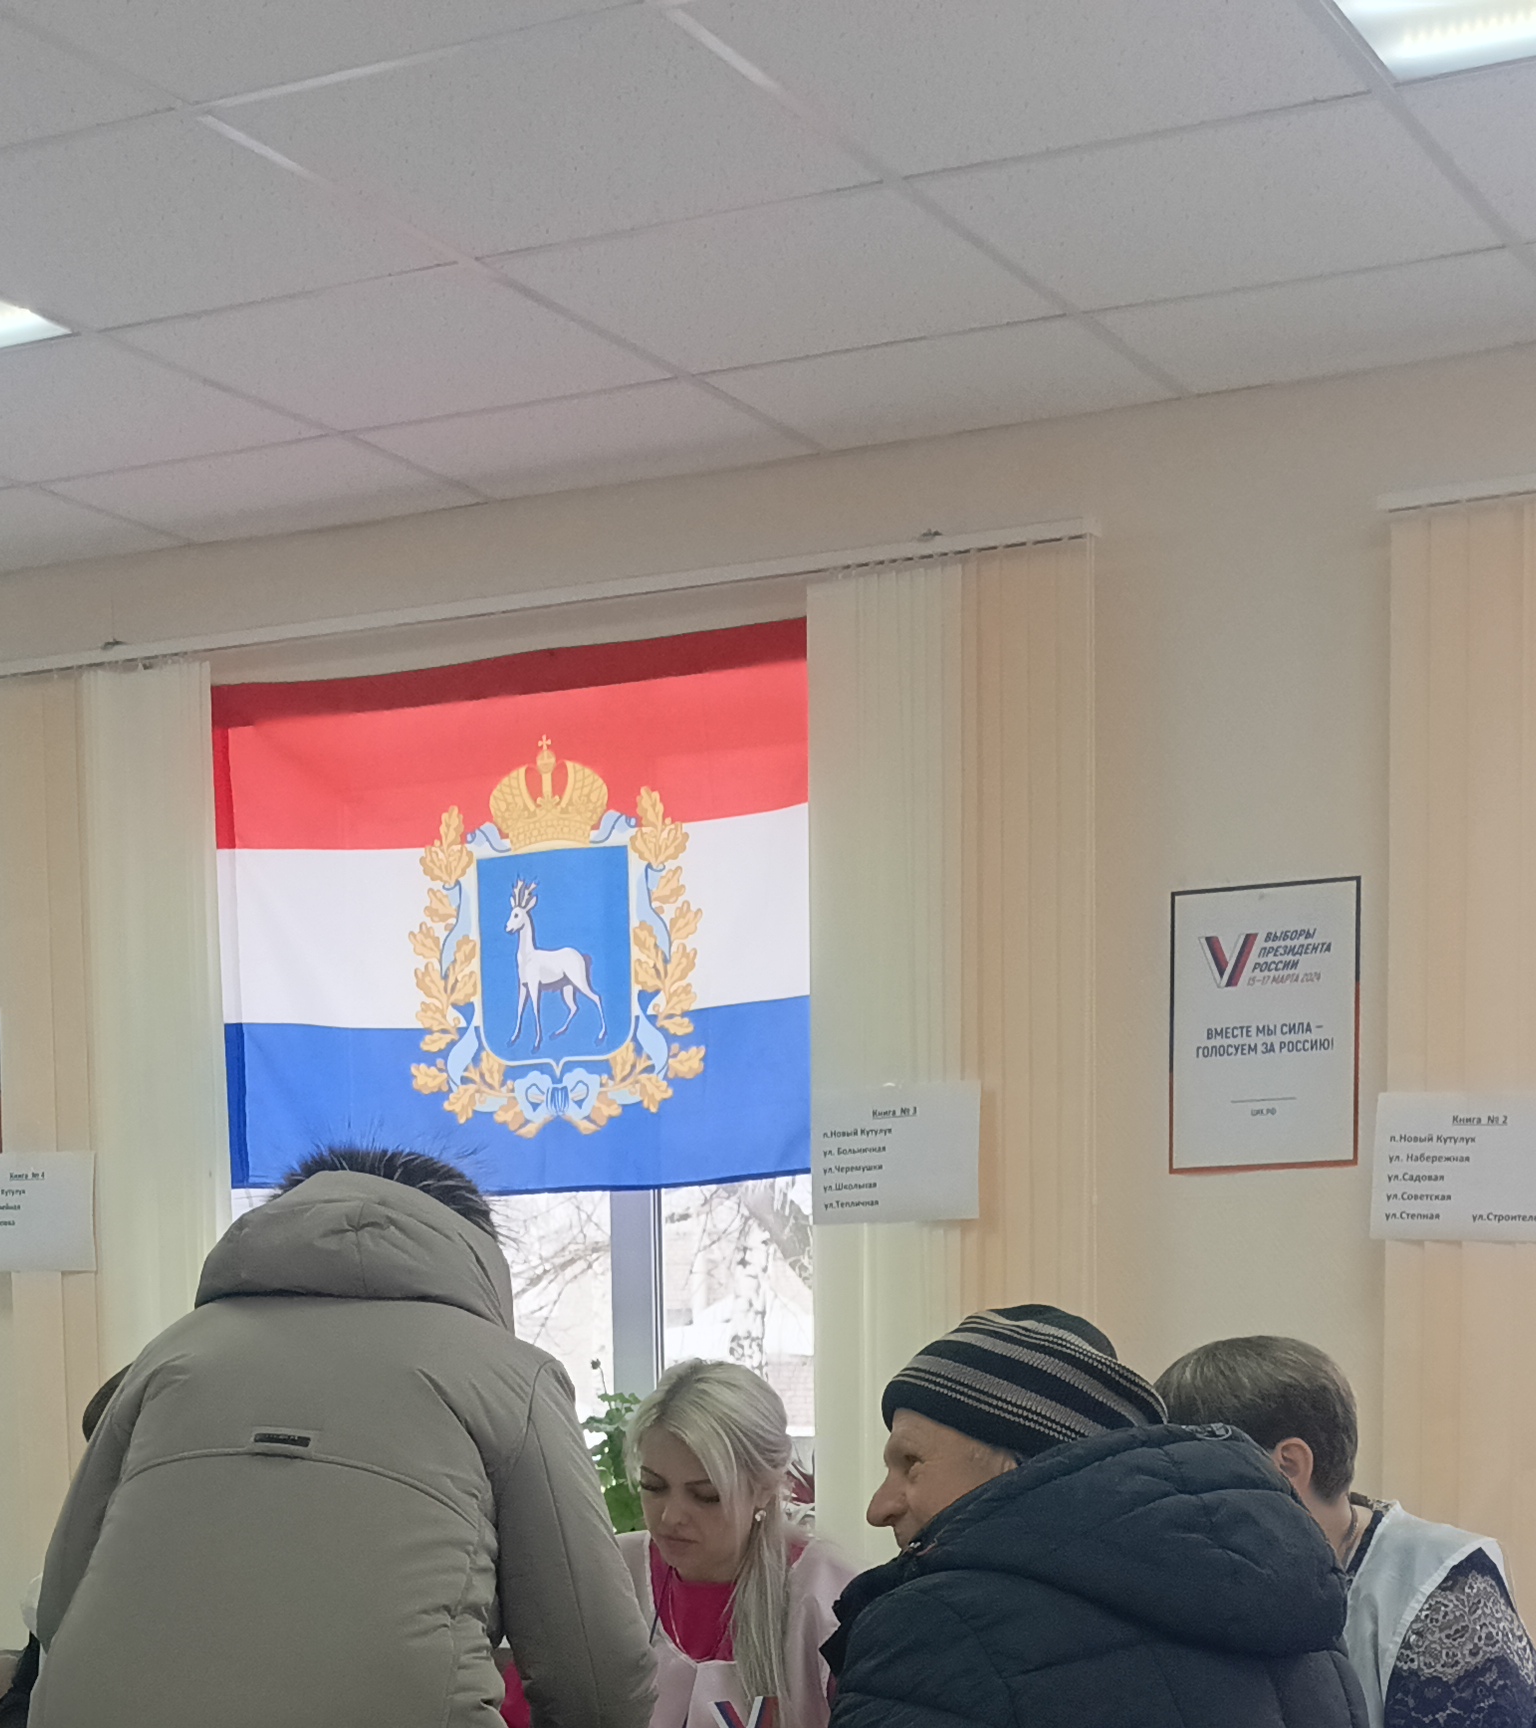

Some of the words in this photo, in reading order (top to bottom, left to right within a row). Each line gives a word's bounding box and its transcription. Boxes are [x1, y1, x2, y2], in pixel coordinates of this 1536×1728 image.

[1264, 928, 1317, 943] ВЫБОРЫ
[1258, 942, 1332, 958] ПРЕЗИДЕНТА
[1252, 959, 1300, 973] РОССИИ
[1270, 973, 1299, 985] МАРТА
[1206, 1025, 1252, 1040] ВМЕСТЕ
[1256, 1024, 1277, 1037] МЫ
[1280, 1021, 1312, 1036] СИЛА
[1196, 1042, 1258, 1059] ГОЛОСУЕМ
[1261, 1041, 1276, 1055] ЗА
[1279, 1037, 1334, 1053] РОССИЮ!
[872, 1109, 896, 1119] Книга
[900, 1107, 910, 1116] №
[1452, 1115, 1482, 1126] Книга
[1487, 1115, 1499, 1126] №
[1502, 1115, 1508, 1125] 2
[823, 1128, 858, 1138] п.Новый
[860, 1127, 892, 1138] Кутулук
[1390, 1134, 1434, 1143] п.Новый
[1436, 1134, 1476, 1145] Кутулук
[837, 1146, 887, 1156] Больничная
[1388, 1154, 1403, 1163] ул.
[1406, 1152, 1471, 1164] Набережная
[823, 1164, 883, 1176] ул.Черемушки
[1387, 1172, 1445, 1183] ул.Садовая
[824, 1182, 877, 1193] ул.Школьная
[1386, 1191, 1452, 1202] ул.Советская
[824, 1200, 879, 1211] ул.Тепличная
[1385, 1211, 1440, 1221] ул.Степная
